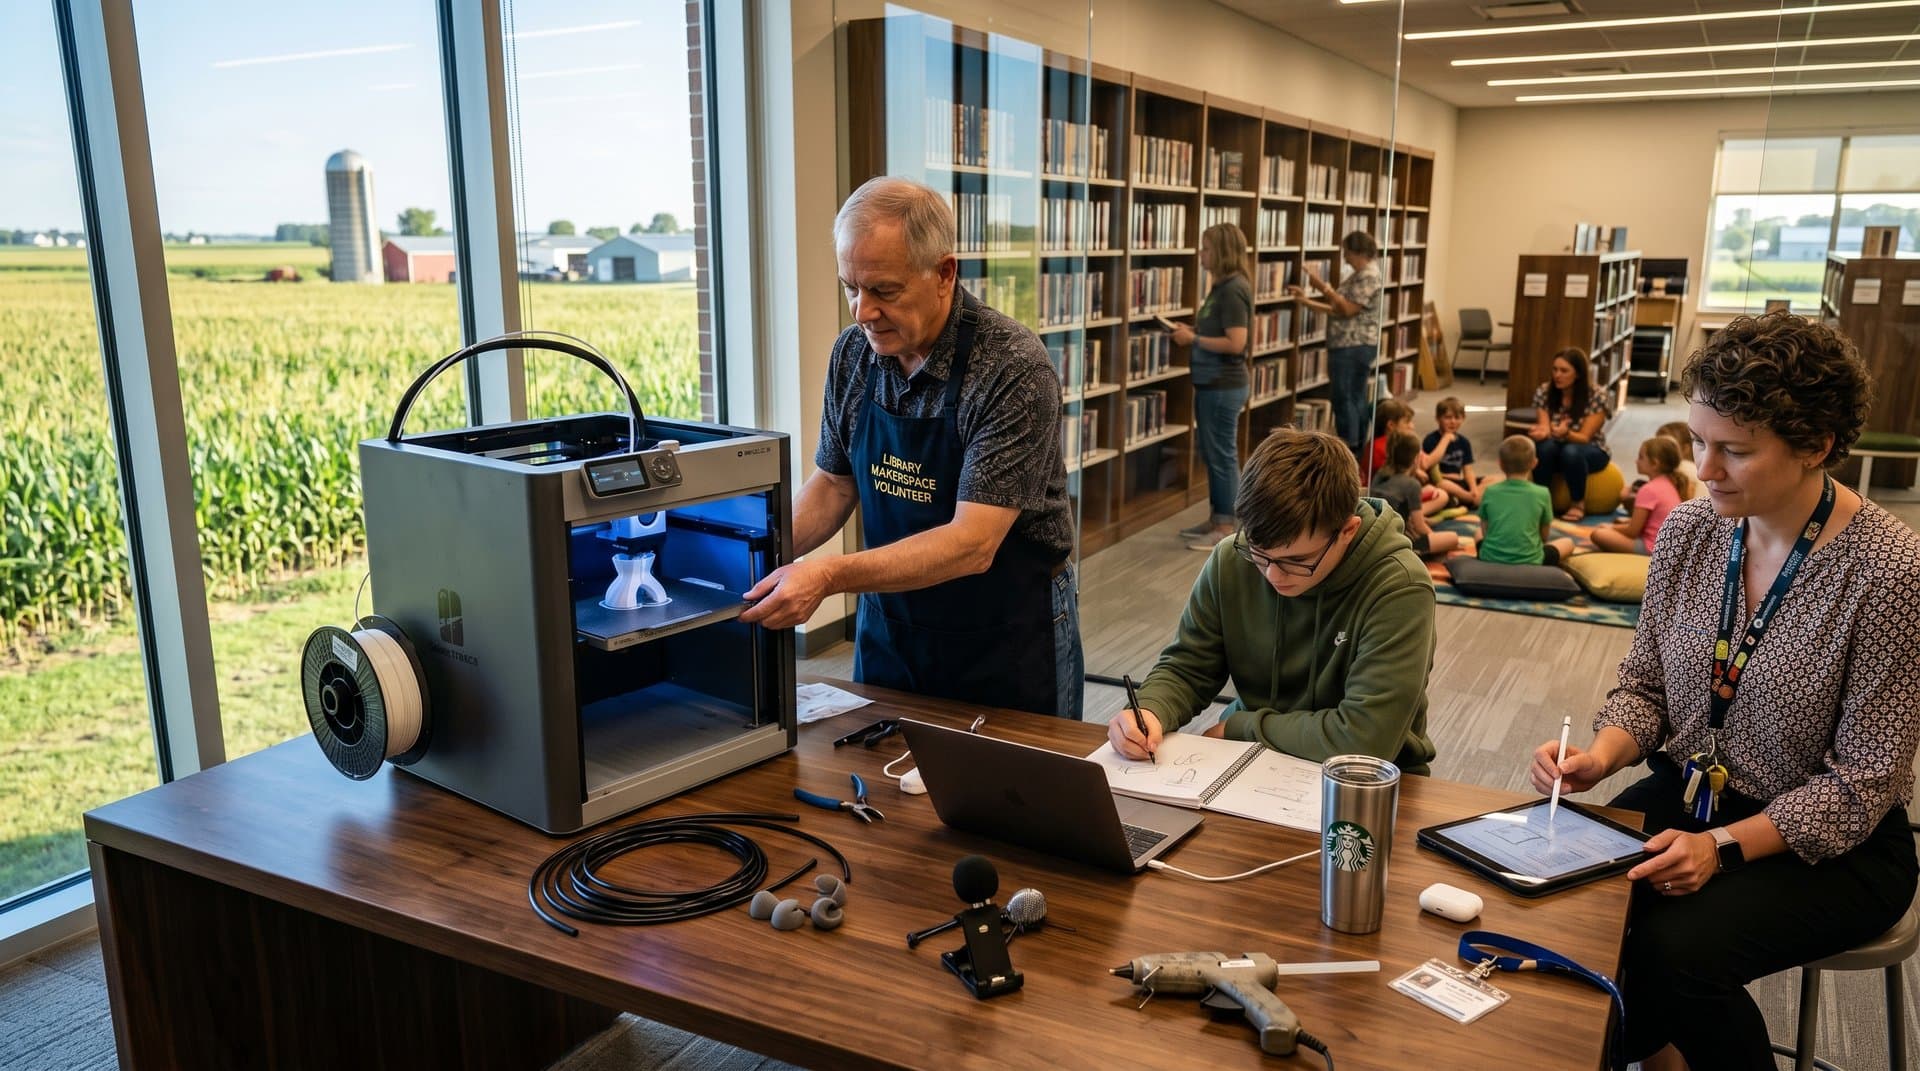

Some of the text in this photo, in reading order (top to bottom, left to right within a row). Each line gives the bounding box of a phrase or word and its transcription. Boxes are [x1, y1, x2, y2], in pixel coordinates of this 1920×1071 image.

[883, 453, 922, 474] LIBRARY
[871, 464, 936, 490] MAKERSPACE
[874, 479, 932, 503] VOLUNTEER
